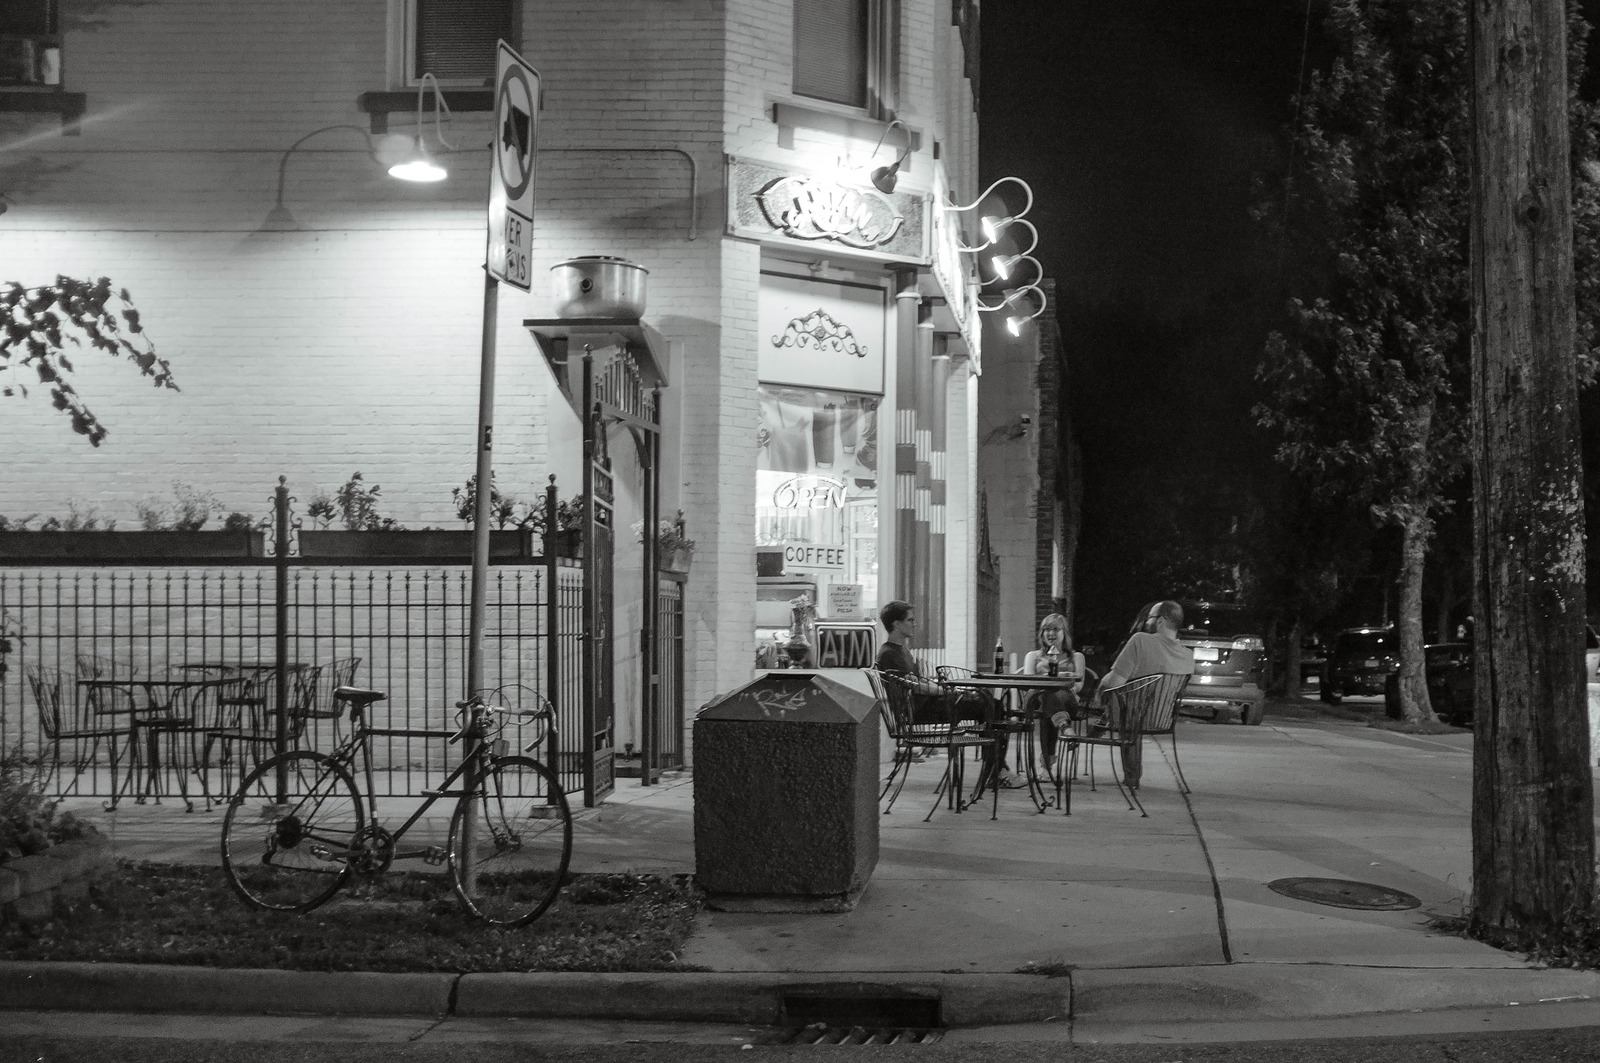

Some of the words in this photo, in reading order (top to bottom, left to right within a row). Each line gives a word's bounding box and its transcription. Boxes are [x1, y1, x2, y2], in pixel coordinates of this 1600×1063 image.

[779, 486, 848, 509] OPEN
[785, 546, 845, 565] COFFEE
[820, 630, 871, 667] ATM
